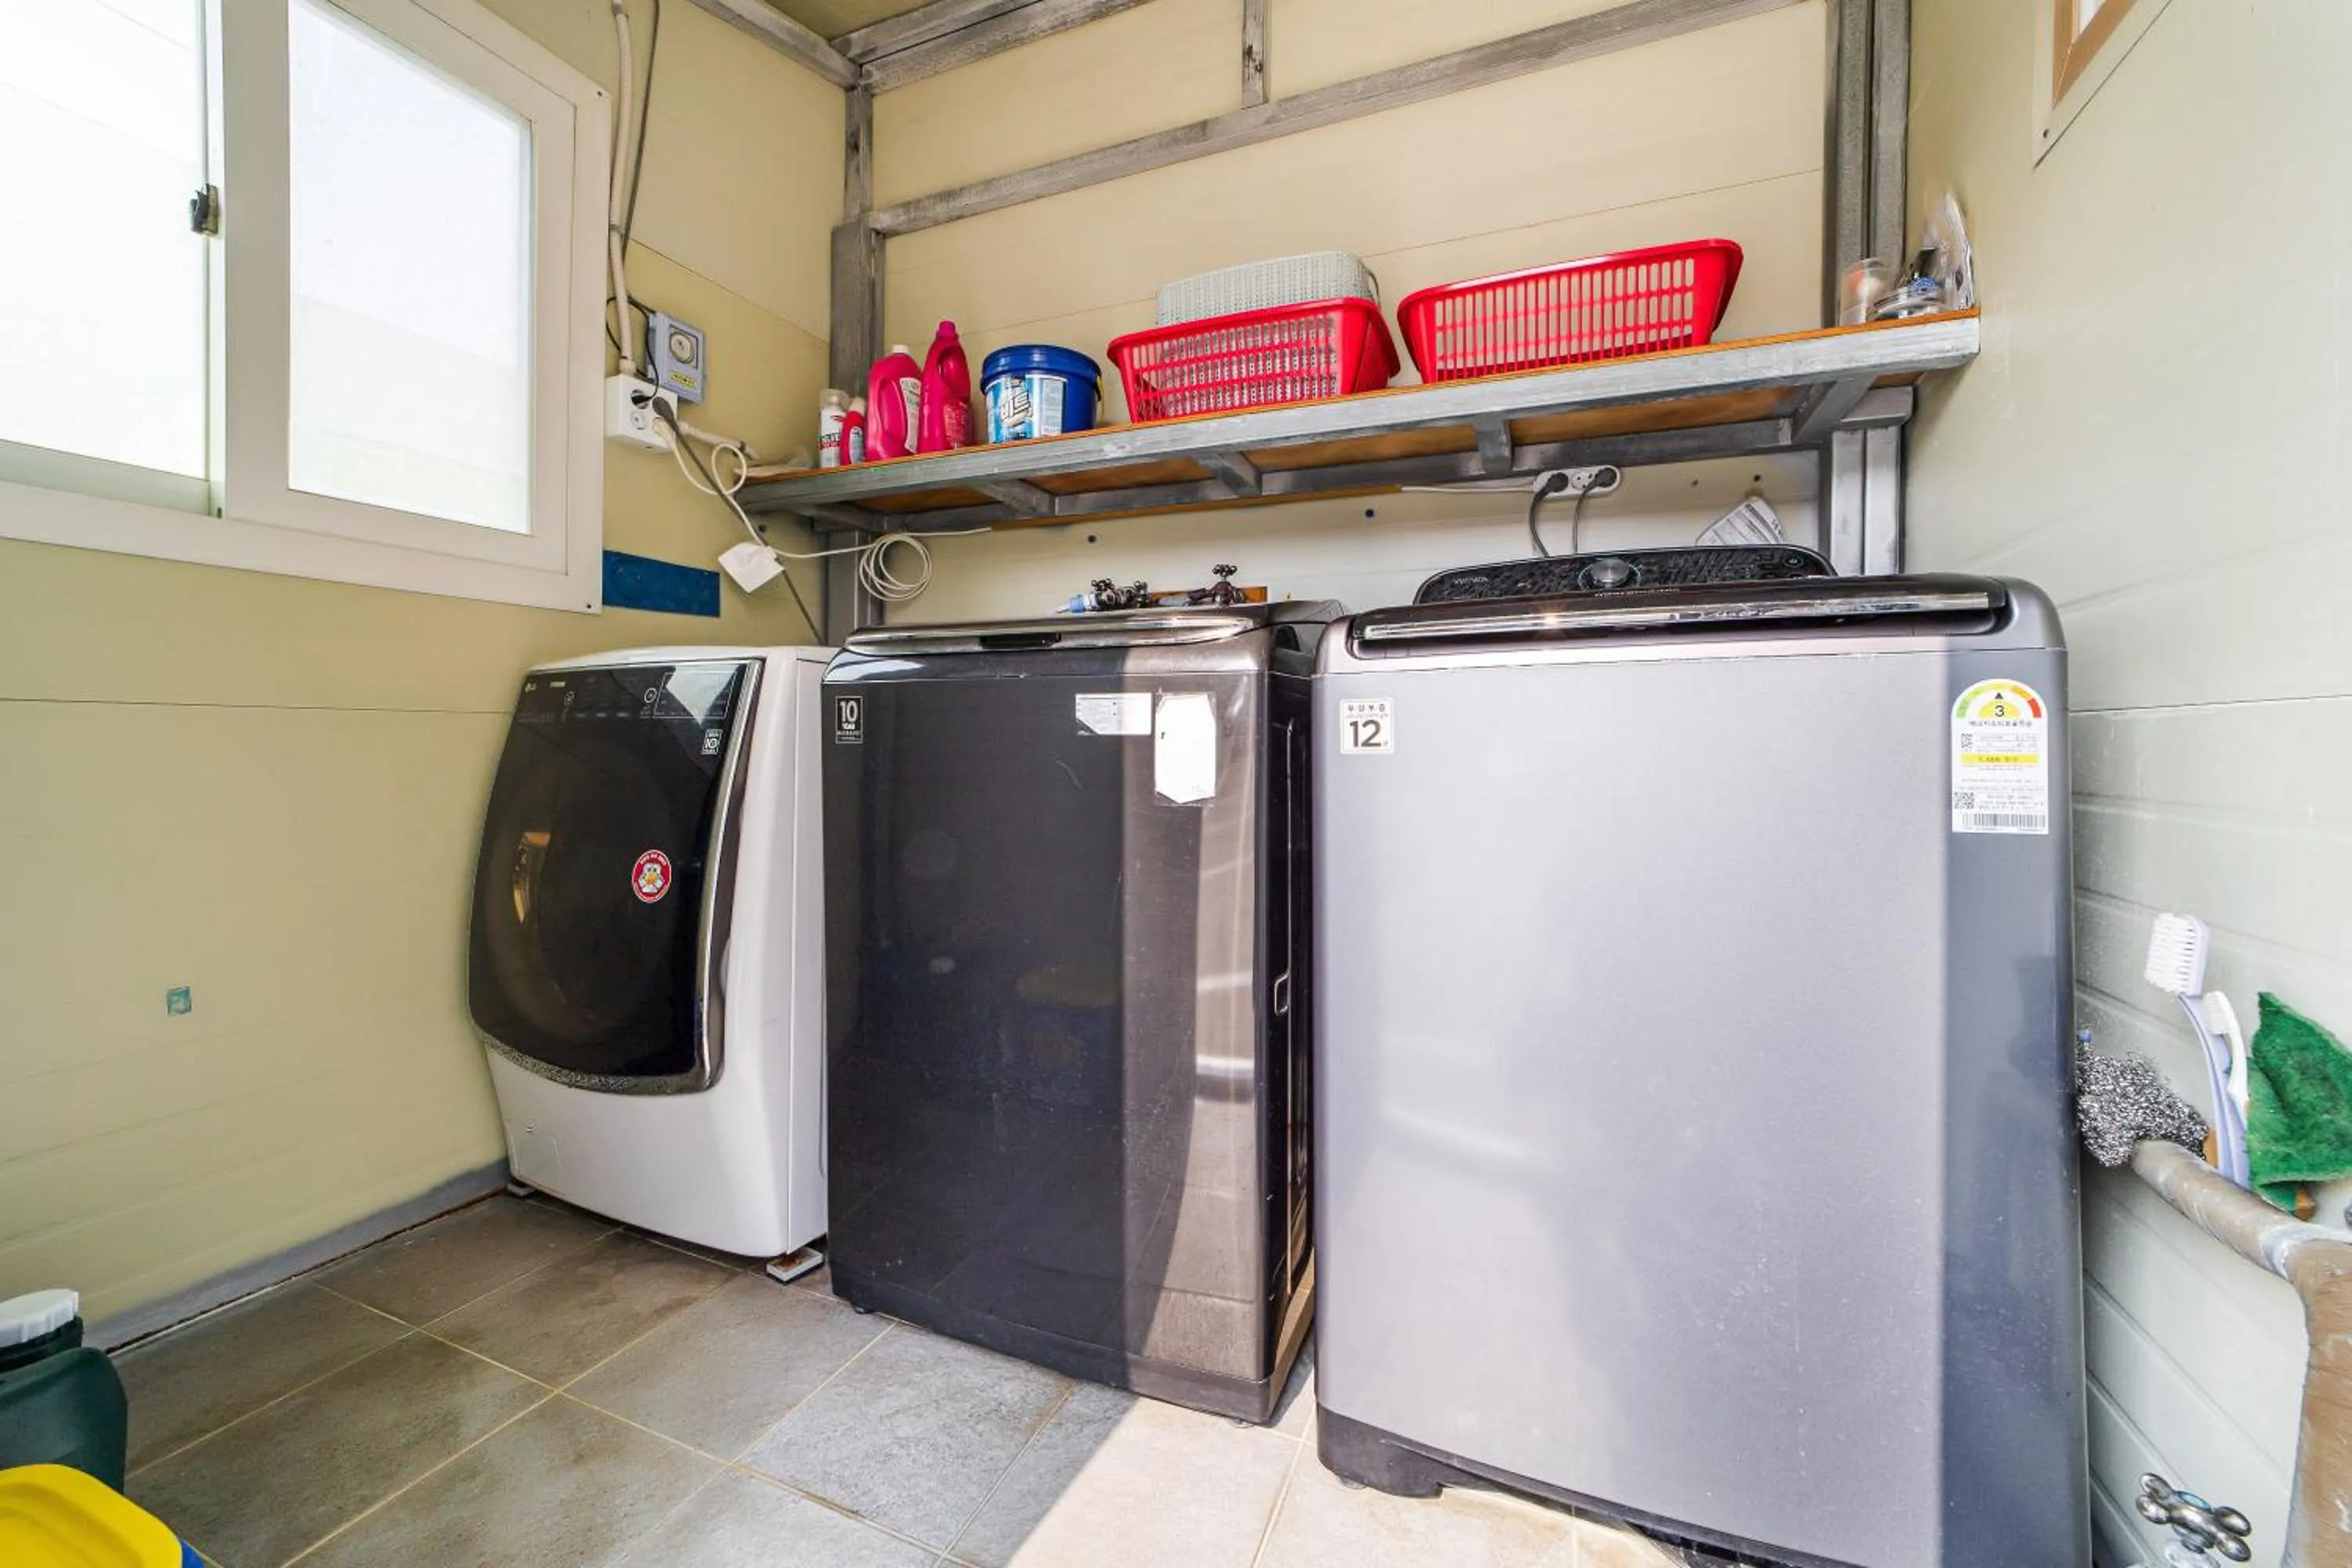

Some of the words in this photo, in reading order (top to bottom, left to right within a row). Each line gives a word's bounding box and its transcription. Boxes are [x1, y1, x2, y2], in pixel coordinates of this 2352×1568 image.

[840, 700, 858, 722] 10
[1994, 705, 2005, 717] 3
[1349, 719, 1382, 748] 12
